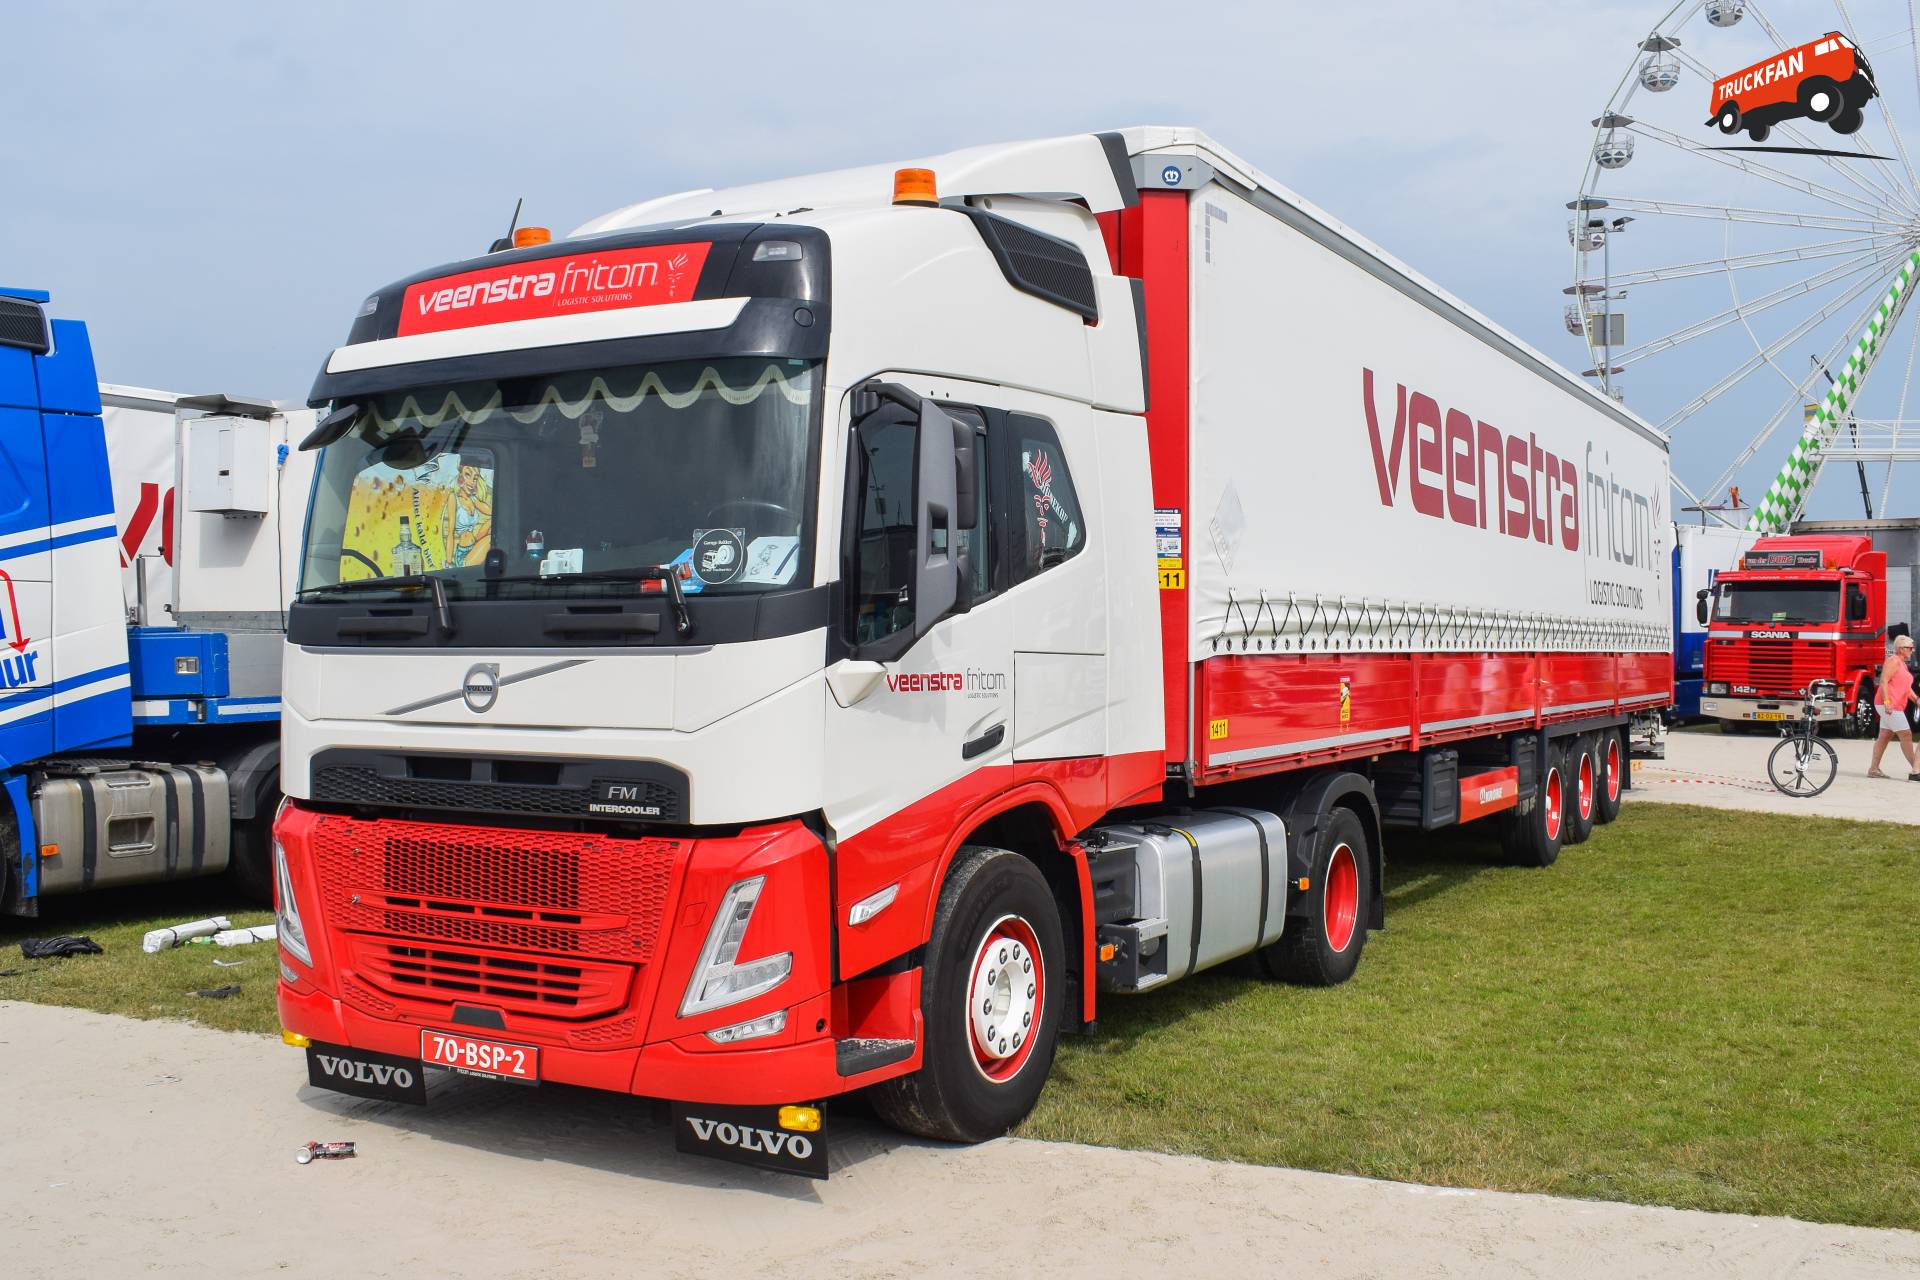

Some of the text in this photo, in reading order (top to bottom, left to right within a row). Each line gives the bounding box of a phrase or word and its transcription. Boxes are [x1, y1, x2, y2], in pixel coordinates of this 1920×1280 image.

[419, 258, 659, 315] veenstra fritom
[557, 292, 633, 307] LOGISTIC SOLUTIONS
[1585, 440, 1651, 571] fritom
[1159, 572, 1180, 587] 11
[1590, 579, 1644, 610] LOGISTIC SOLUTIONS
[1751, 630, 1791, 639] SCANIA
[465, 684, 493, 693] VOLVO
[886, 667, 1006, 693] veenstra fritom
[1211, 721, 1226, 737] 1411
[608, 786, 638, 800] FM
[589, 803, 660, 816] INTERCOOLER
[433, 1036, 526, 1075] 70-BSP-2
[315, 1053, 414, 1089] VOLVO
[685, 1116, 813, 1160] VOLVO
